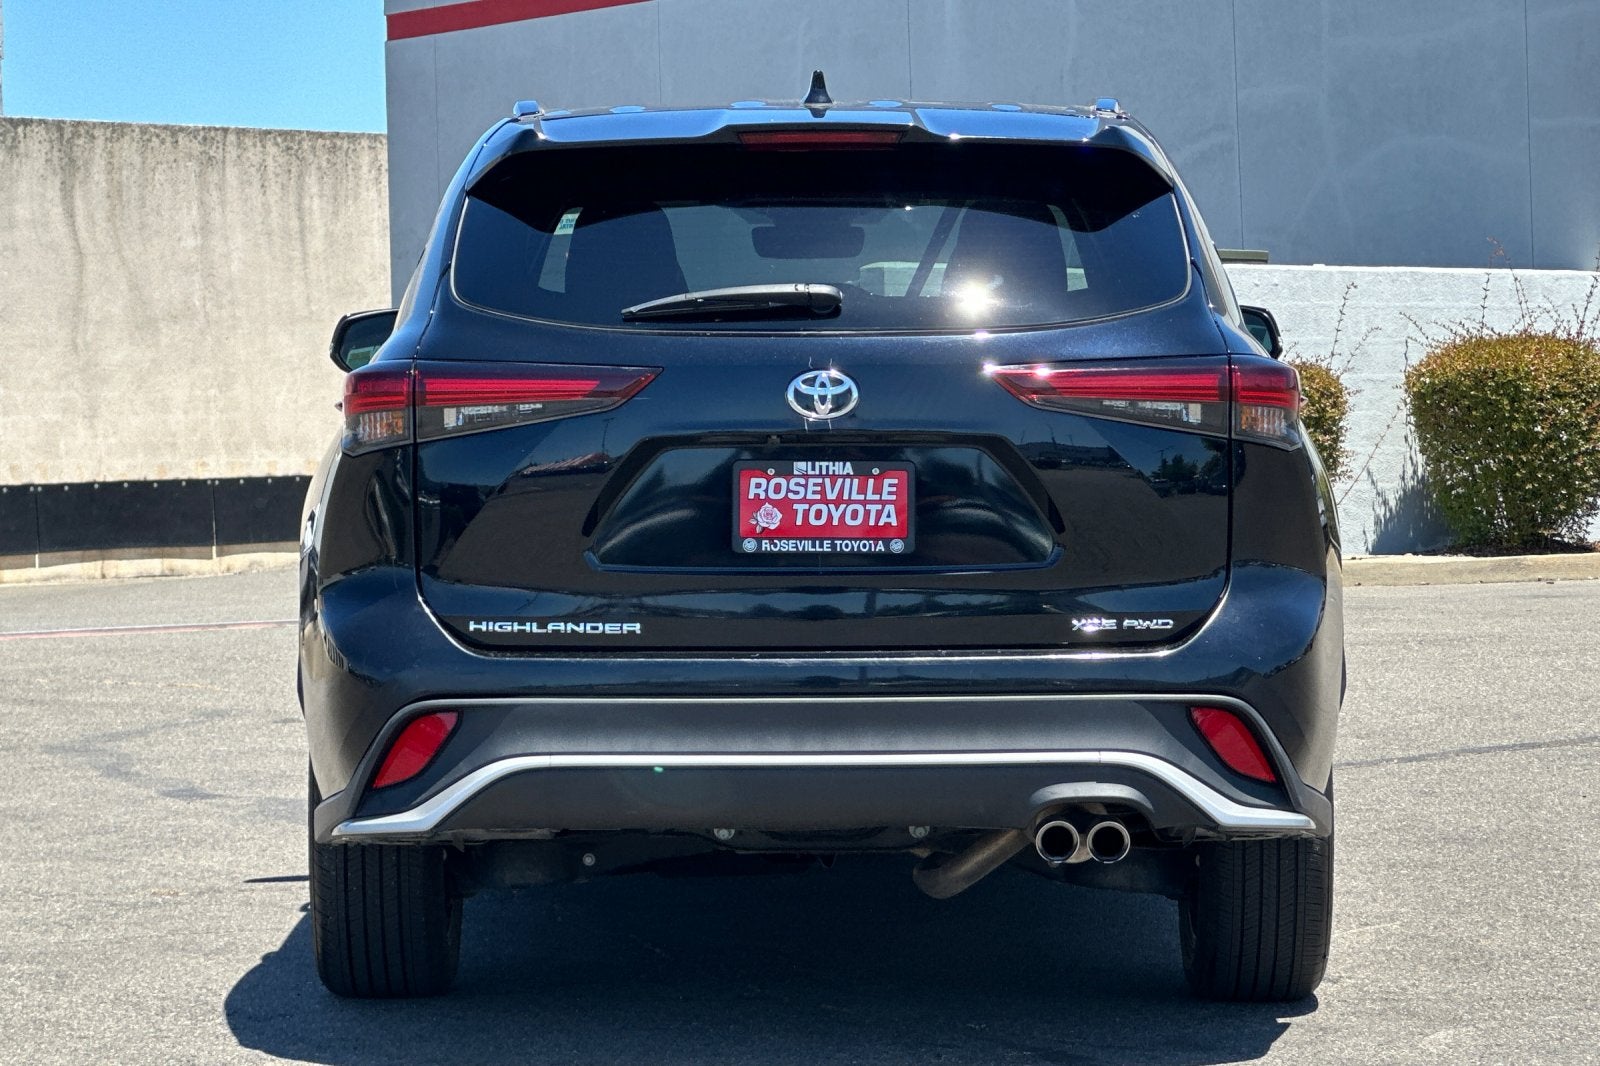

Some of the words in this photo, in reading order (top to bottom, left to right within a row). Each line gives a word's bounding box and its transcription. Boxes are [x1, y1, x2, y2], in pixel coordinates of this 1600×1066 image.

[807, 461, 853, 475] LITHIA
[748, 477, 898, 500] ROSEVILLE
[793, 503, 898, 526] TOYOTA
[761, 539, 831, 551] ROSEVILLE
[834, 540, 885, 552] TOYOTA
[468, 620, 642, 634] HIGHLANDER
[1123, 619, 1174, 630] AWD
